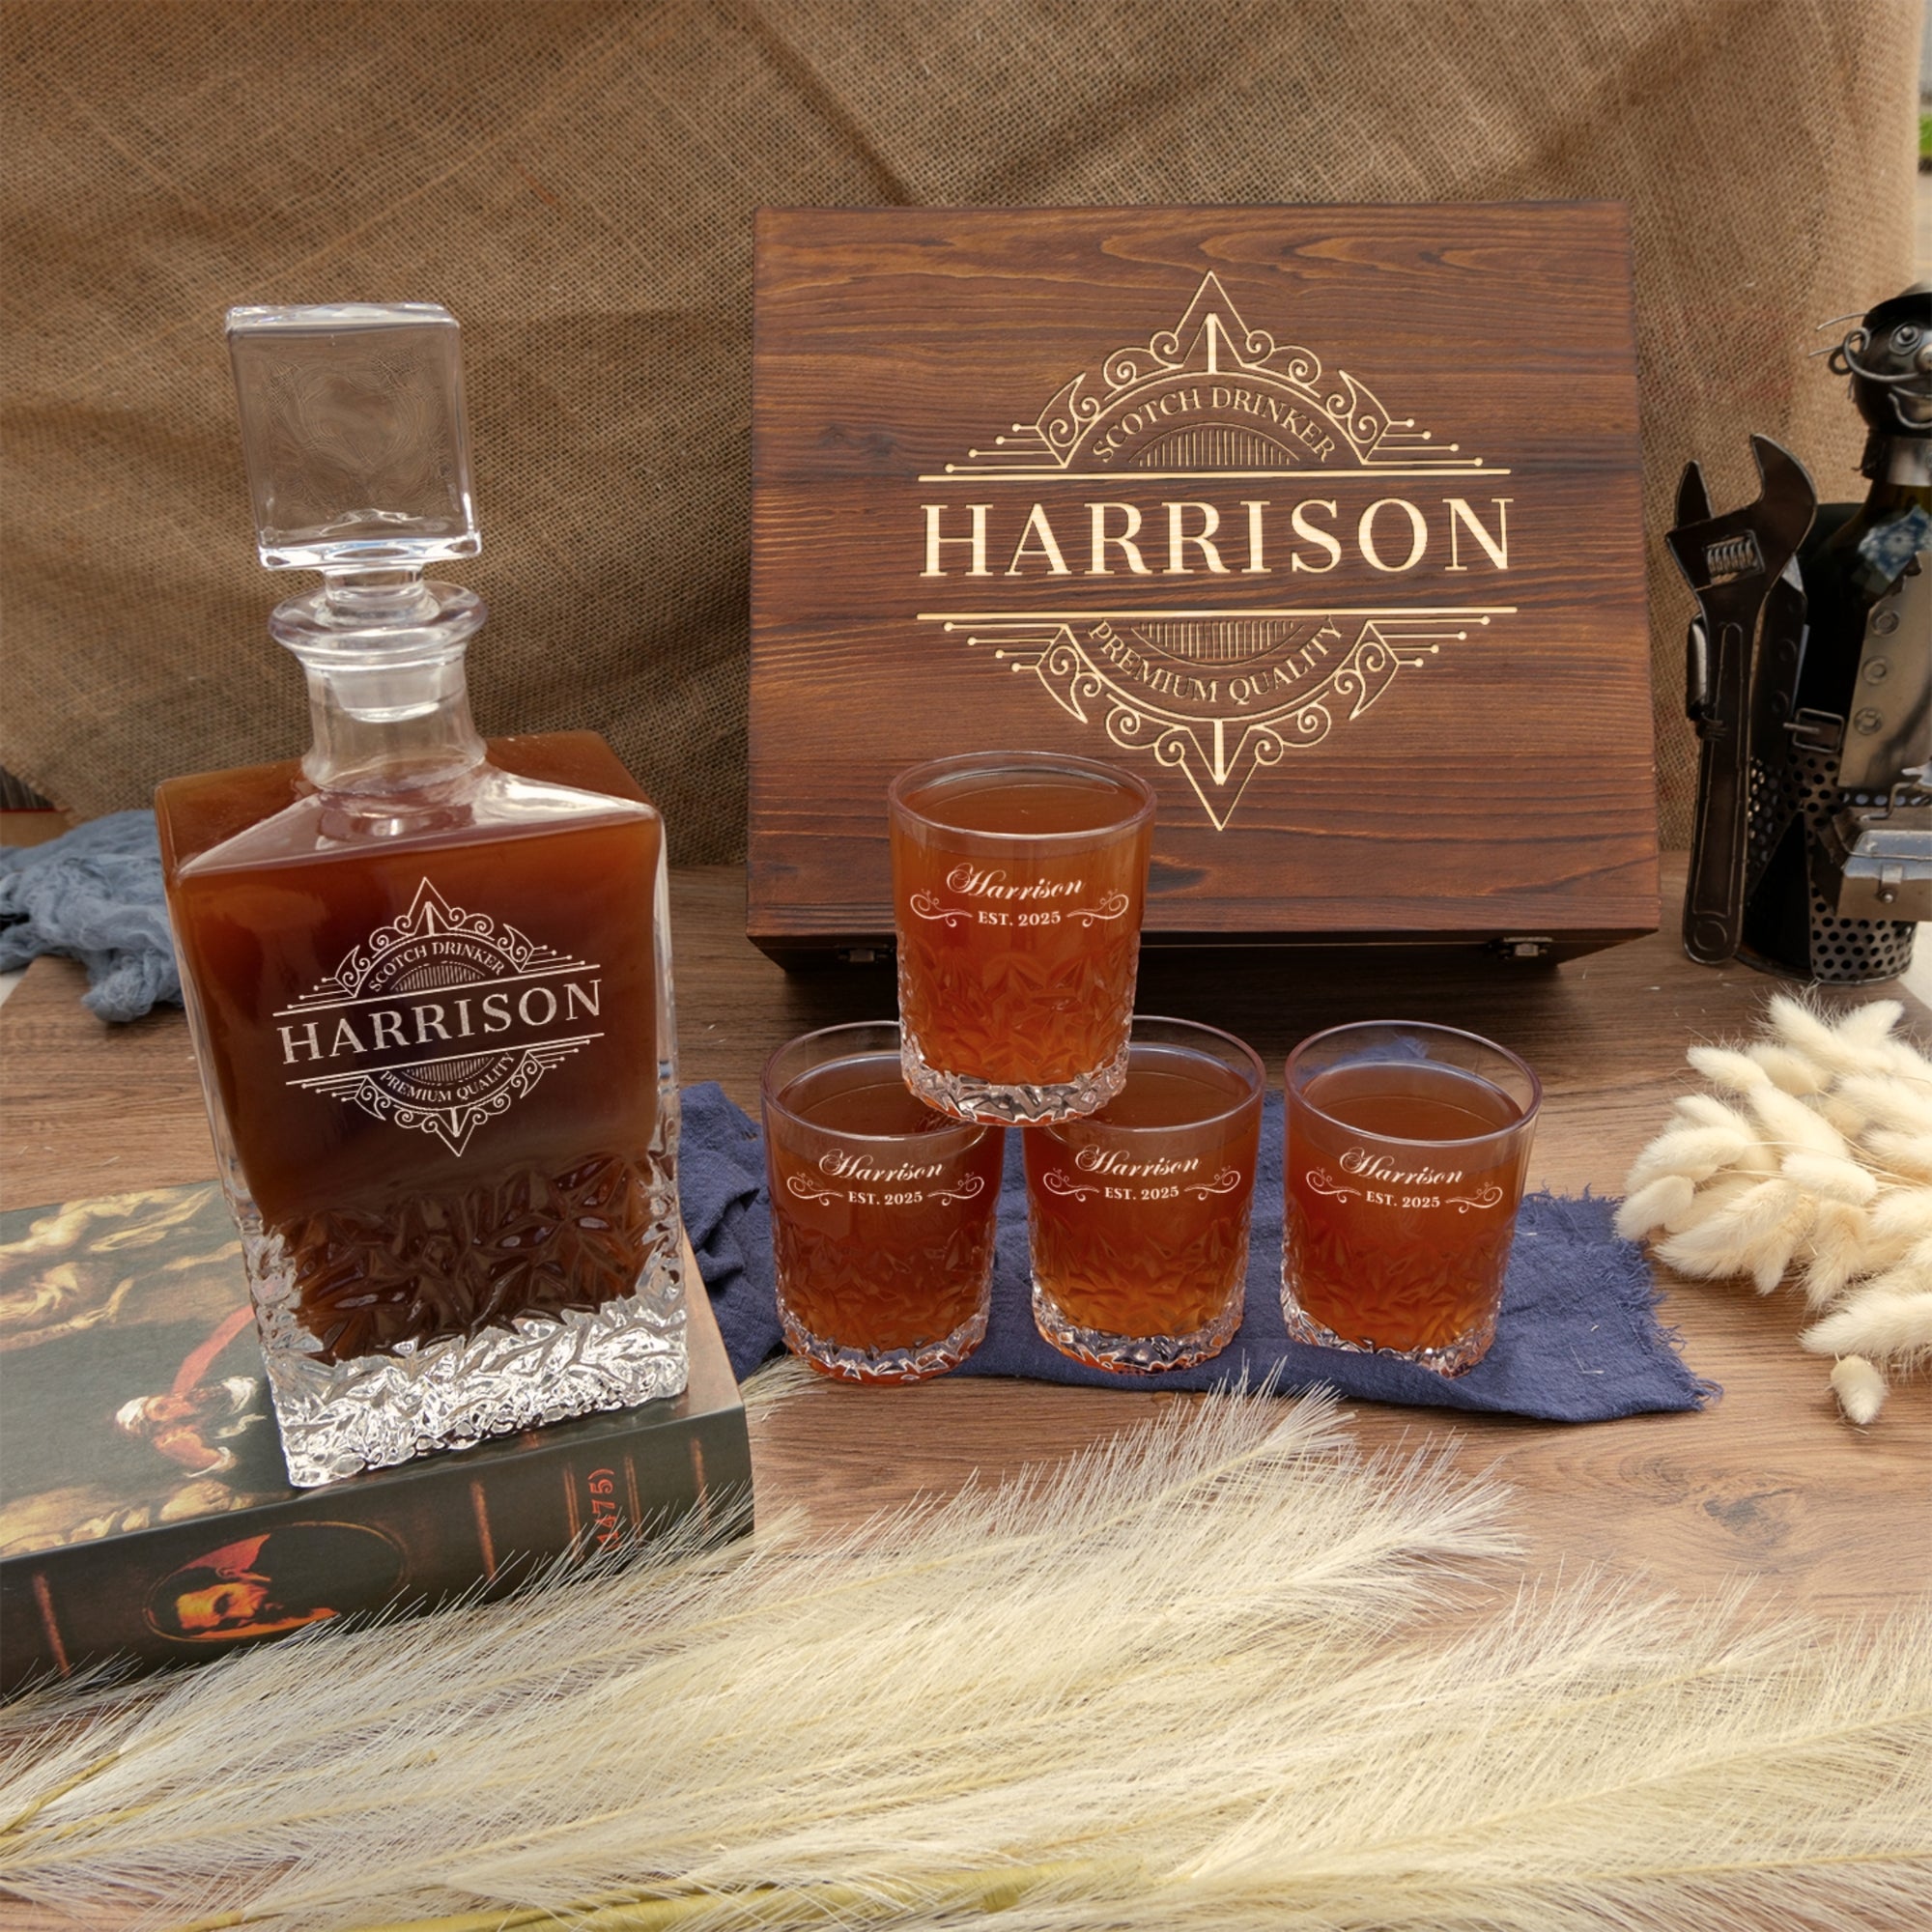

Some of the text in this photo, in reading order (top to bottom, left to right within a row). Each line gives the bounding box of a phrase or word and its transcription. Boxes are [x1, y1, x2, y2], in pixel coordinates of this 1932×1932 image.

[1093, 386, 1335, 463] SCOTCH DRINKER
[919, 497, 1514, 577] HARRISON
[1089, 614, 1344, 705] PREMIUM QUALITY
[946, 863, 1086, 901] Harrison
[978, 911, 1061, 927] EST. 2025
[369, 942, 505, 992] SCOTCH DRINKER
[276, 979, 602, 1065] HARRISON
[380, 1053, 515, 1101] PREMIUM QUALITY
[819, 1149, 945, 1181] Harrison
[1074, 1144, 1201, 1177] Harrison
[1339, 1147, 1464, 1184] Harrison
[848, 1191, 923, 1206] EST. 2025
[1104, 1185, 1179, 1201] EST. 2025
[1366, 1190, 1440, 1208] EST. 2025
